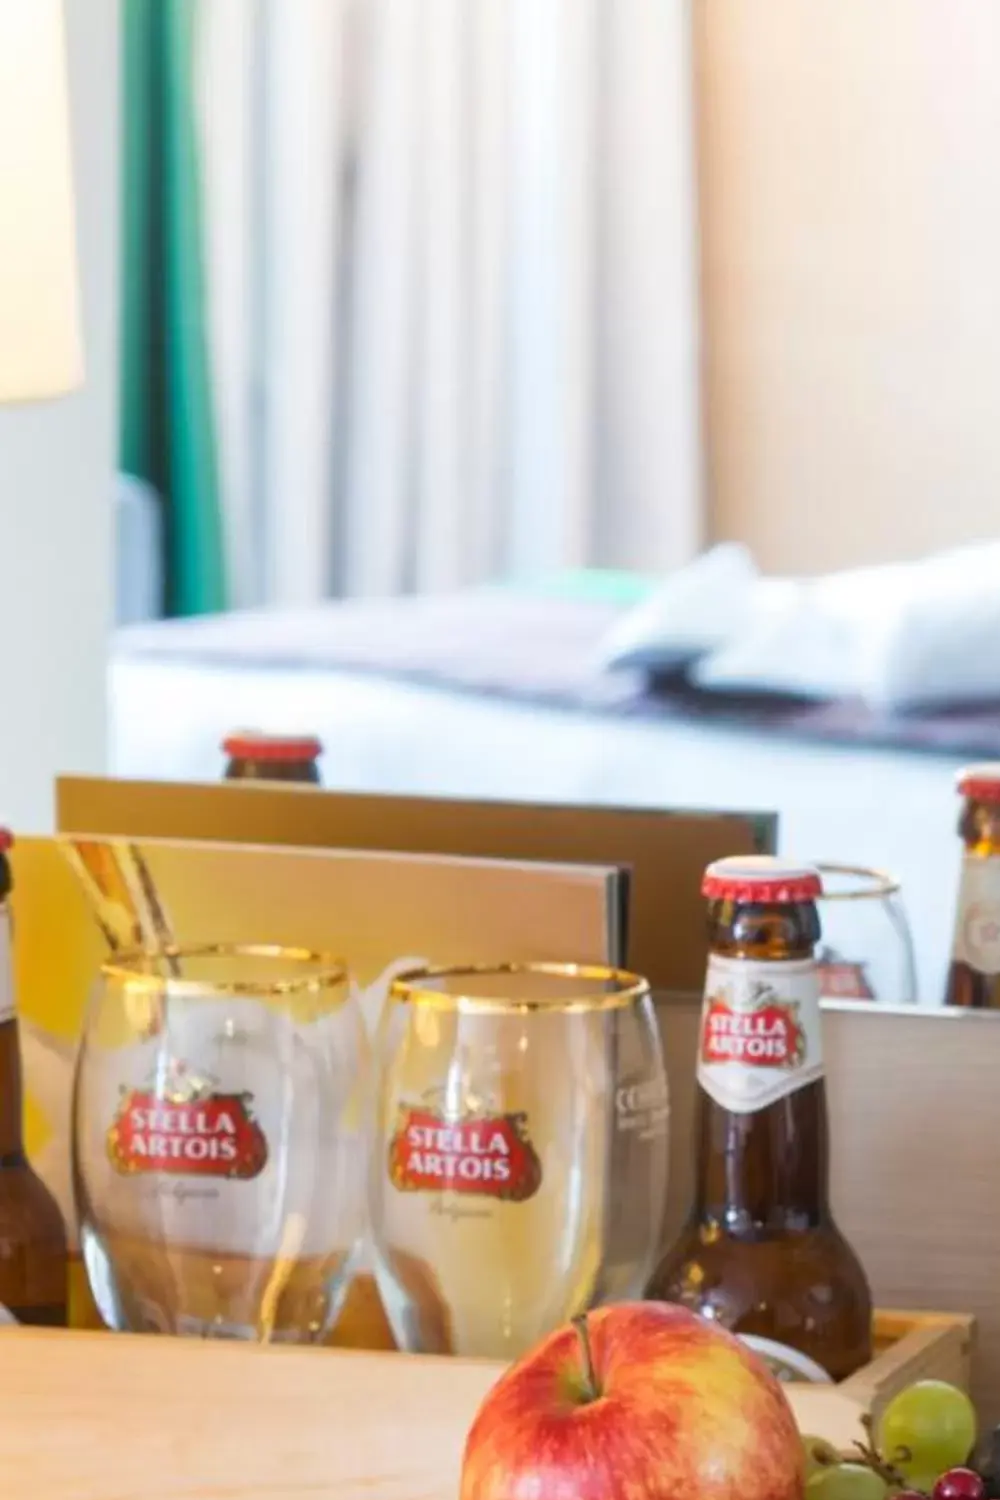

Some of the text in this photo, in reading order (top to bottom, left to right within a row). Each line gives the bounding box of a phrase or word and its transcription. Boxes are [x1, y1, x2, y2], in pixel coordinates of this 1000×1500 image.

[709, 1013, 786, 1036] STELLA
[709, 1034, 787, 1058] ARTOIS
[130, 1107, 236, 1134] STELLA
[130, 1134, 237, 1160] ARTOIS
[407, 1125, 510, 1155] STELLA
[407, 1152, 511, 1181] ARTOIS
